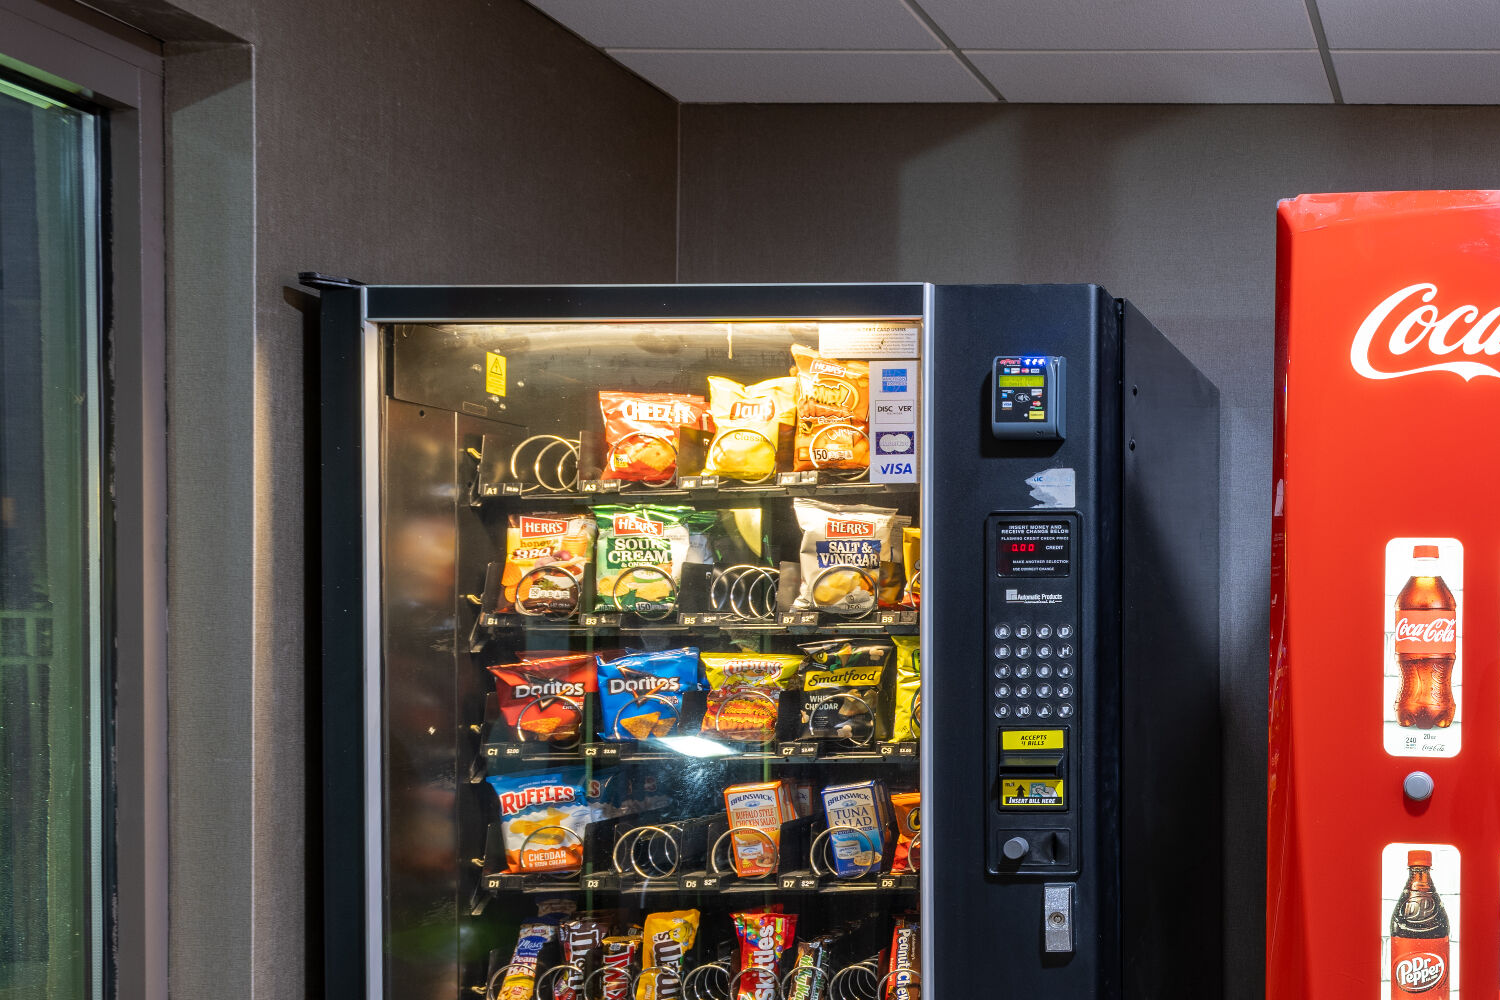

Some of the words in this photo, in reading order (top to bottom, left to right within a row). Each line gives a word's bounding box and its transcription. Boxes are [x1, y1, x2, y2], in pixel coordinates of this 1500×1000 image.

[880, 462, 913, 475] VISA
[486, 487, 498, 495] A1
[584, 484, 597, 492] A3
[524, 521, 563, 534] HERR'S
[829, 520, 869, 535] HERR'S
[828, 541, 859, 554] SALT
[861, 542, 873, 554] &
[607, 549, 670, 564] CREAM
[818, 552, 879, 567] VINEGAR
[1017, 593, 1041, 601] Automatic
[486, 617, 498, 625] B1
[585, 617, 598, 625] B3
[684, 616, 696, 624] B5
[782, 616, 795, 624] B7
[1395, 617, 1457, 643] Coca-Cola
[610, 676, 680, 694] Doritos
[808, 671, 876, 688] Smartfood
[515, 678, 585, 699] Doritos
[1405, 736, 1417, 744] 240
[487, 748, 498, 756] C1
[585, 748, 597, 756] C3
[782, 747, 794, 755] C7
[500, 785, 575, 817] RUFFLES
[730, 793, 773, 806] BRUNSWICK
[827, 792, 870, 807] BRUNSWICK
[735, 809, 759, 820] BUFFALO
[758, 807, 774, 818] STYLE
[833, 806, 869, 820] TUNA
[760, 816, 777, 827] SALAD
[528, 850, 567, 862] CHEDDAR
[488, 880, 500, 888] D1
[587, 880, 599, 888] D3
[685, 880, 697, 888] D5
[783, 880, 795, 888] D7
[1412, 956, 1432, 973] Dr
[1400, 959, 1443, 986] Pepper
